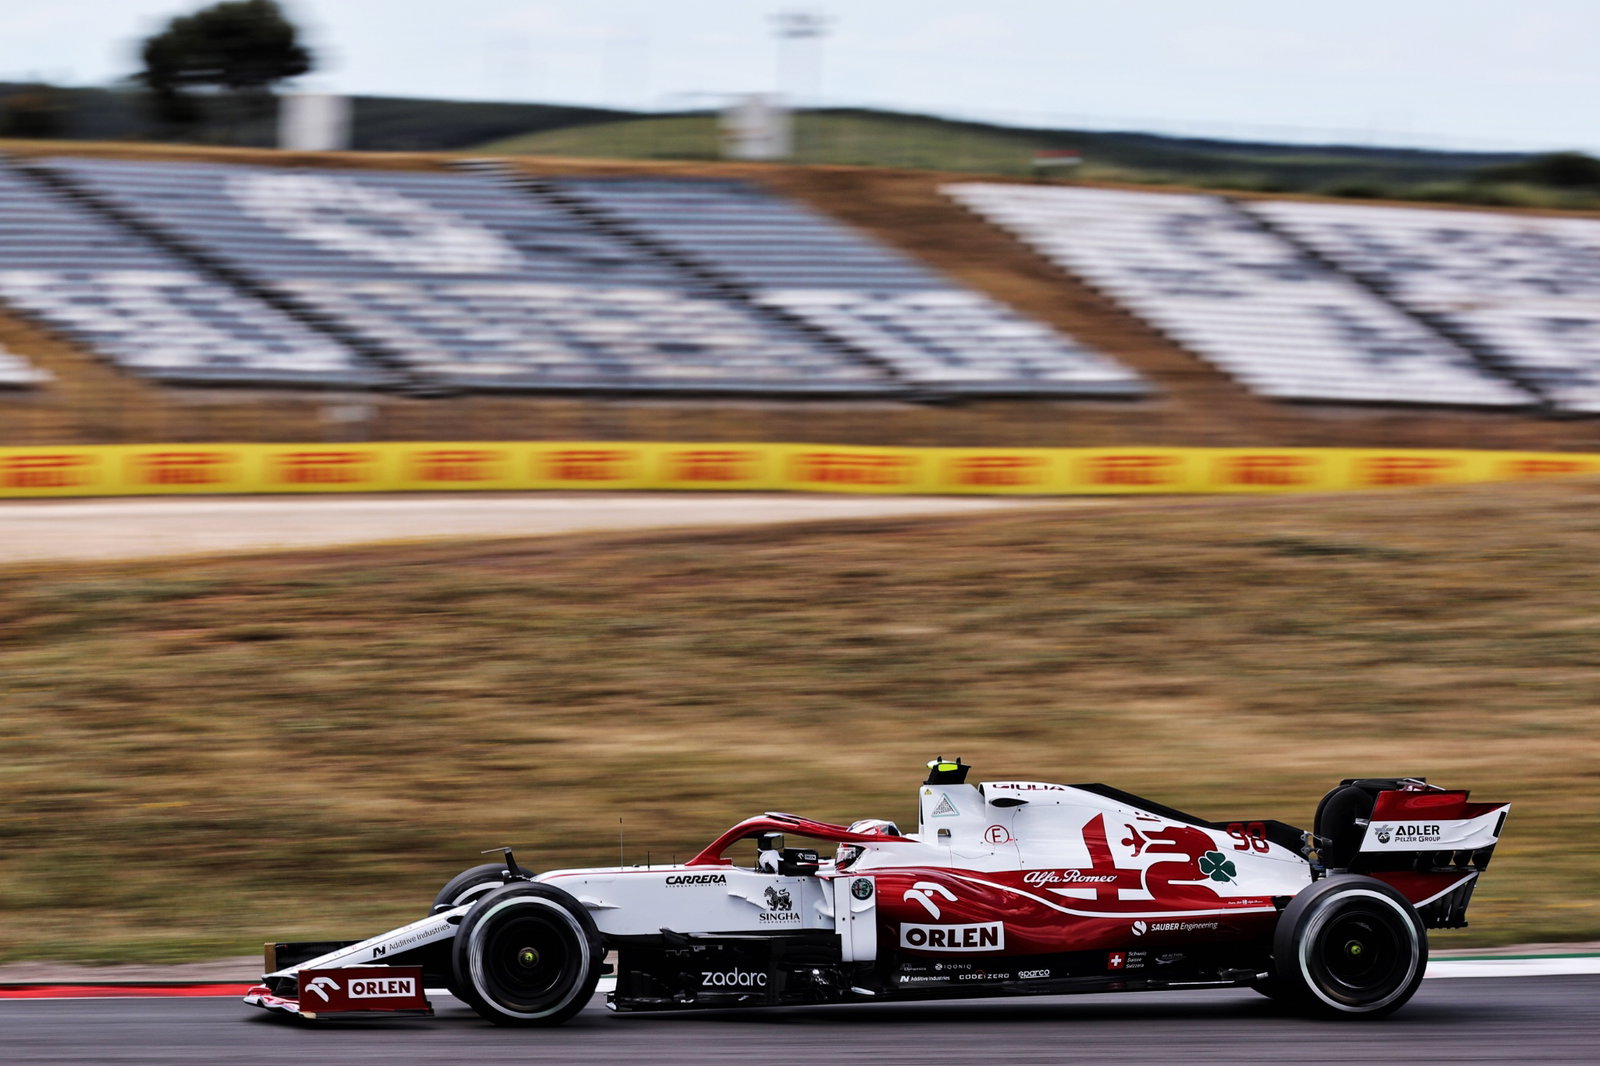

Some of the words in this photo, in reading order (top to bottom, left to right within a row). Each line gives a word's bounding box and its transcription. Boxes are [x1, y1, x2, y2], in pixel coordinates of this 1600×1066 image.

[991, 828, 1003, 843] E
[1395, 825, 1440, 836] ADLER
[666, 874, 727, 885] CARRERA
[1023, 871, 1062, 888] Alfa
[1062, 869, 1118, 883] Romeo
[759, 912, 800, 921] SINGHA
[1151, 923, 1180, 931] SAUBER
[1180, 922, 1218, 931] Engineering
[389, 937, 416, 951] Additive
[416, 923, 451, 941] Industries
[905, 926, 998, 948] ORLEN
[352, 980, 411, 995] ORLEN
